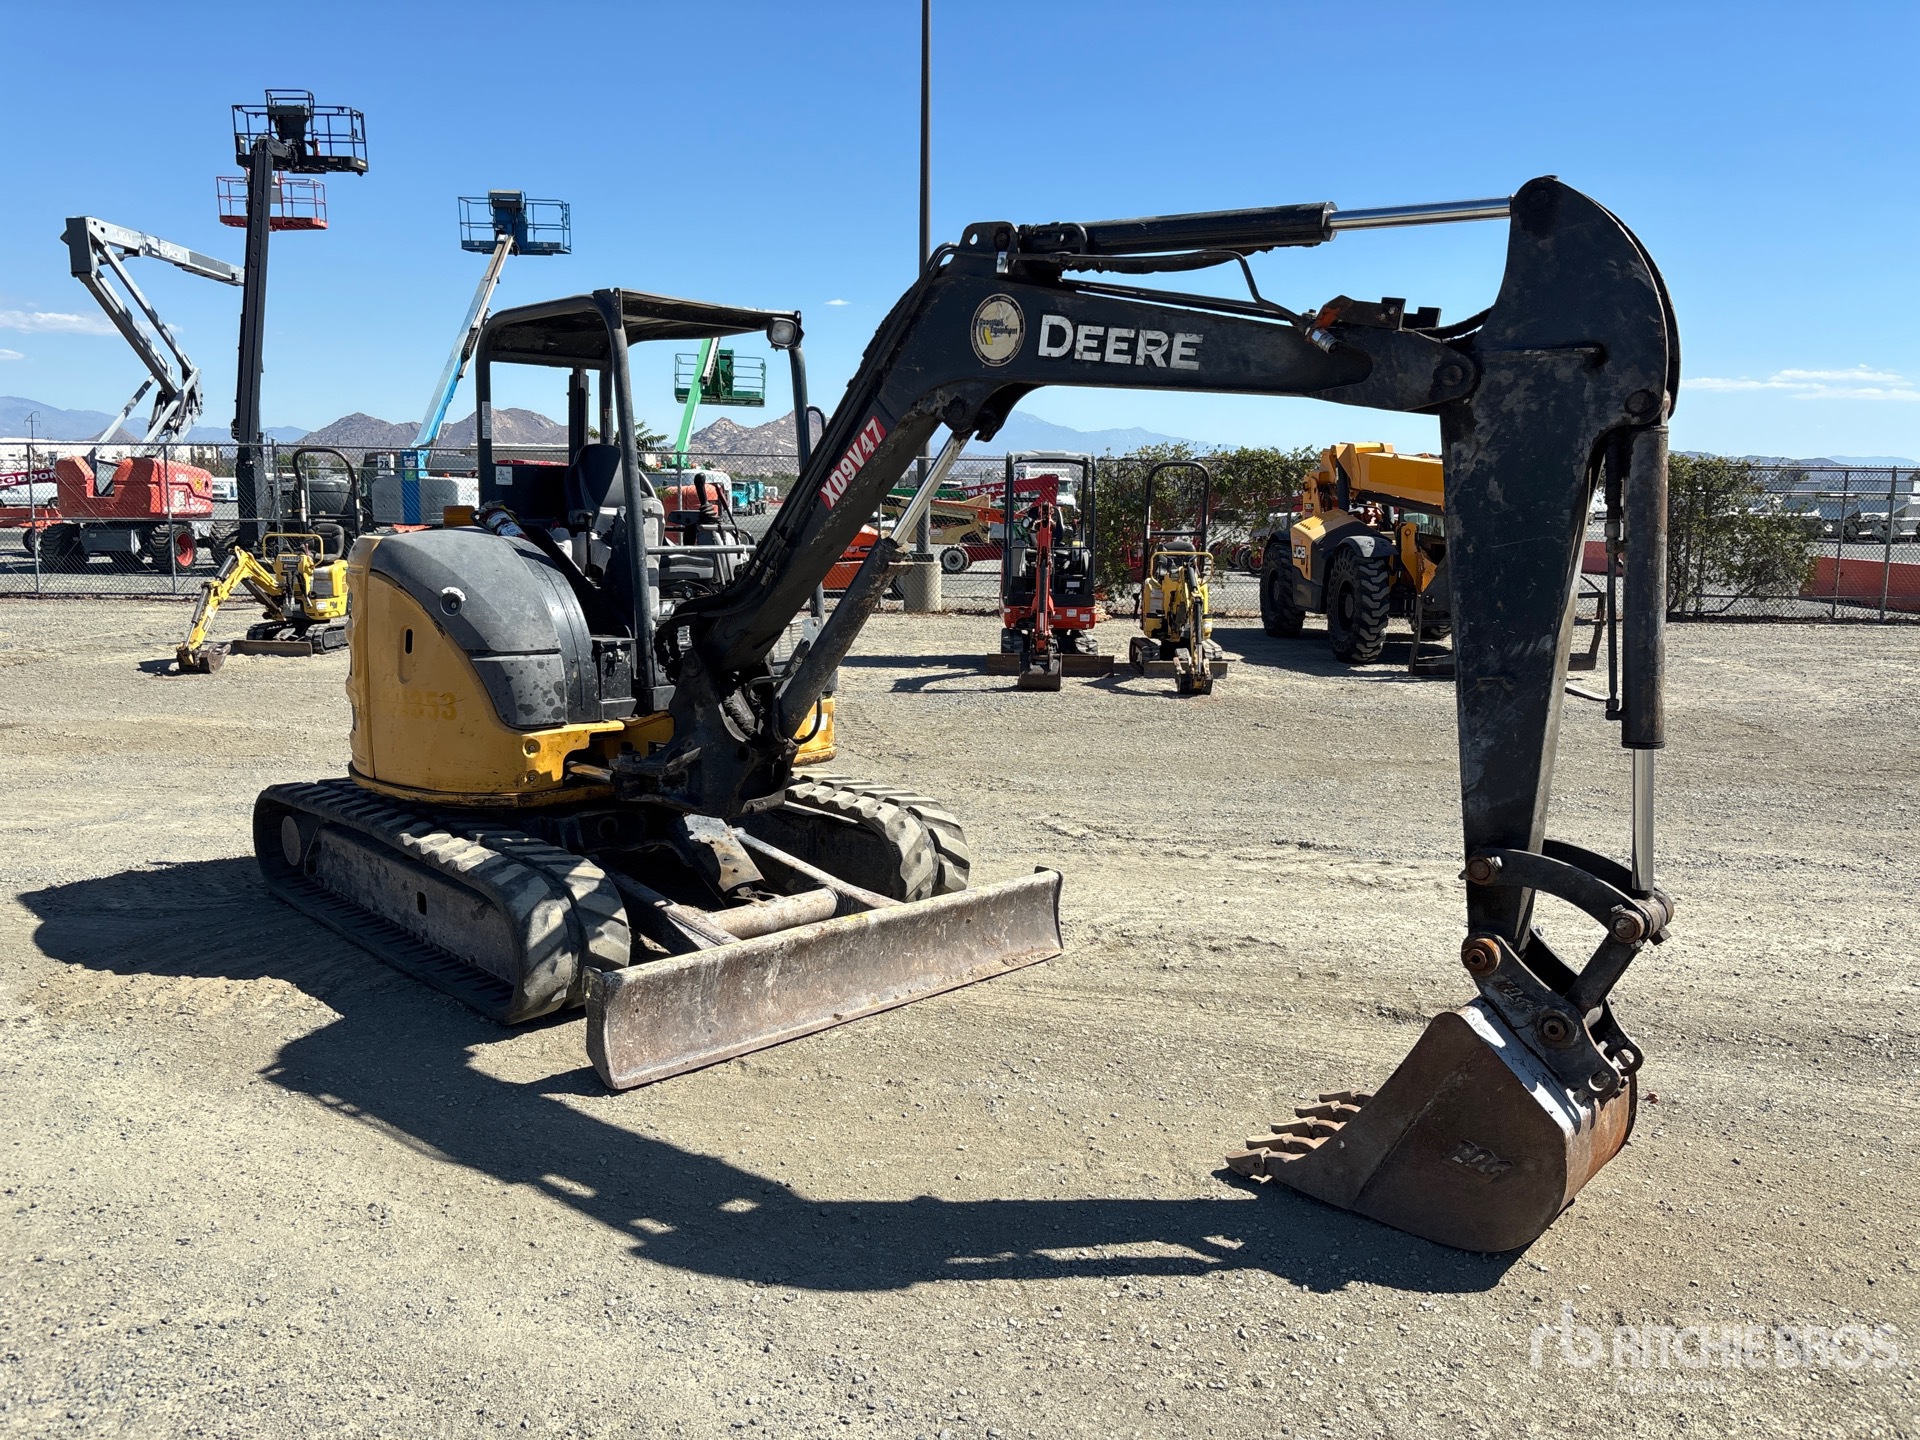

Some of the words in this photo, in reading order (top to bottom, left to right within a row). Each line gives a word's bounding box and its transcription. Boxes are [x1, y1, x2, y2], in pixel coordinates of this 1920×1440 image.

[1038, 314, 1203, 371] DEERE
[379, 460, 390, 469] 28
[820, 418, 882, 508] XD9V47
[1294, 546, 1306, 559] JCB
